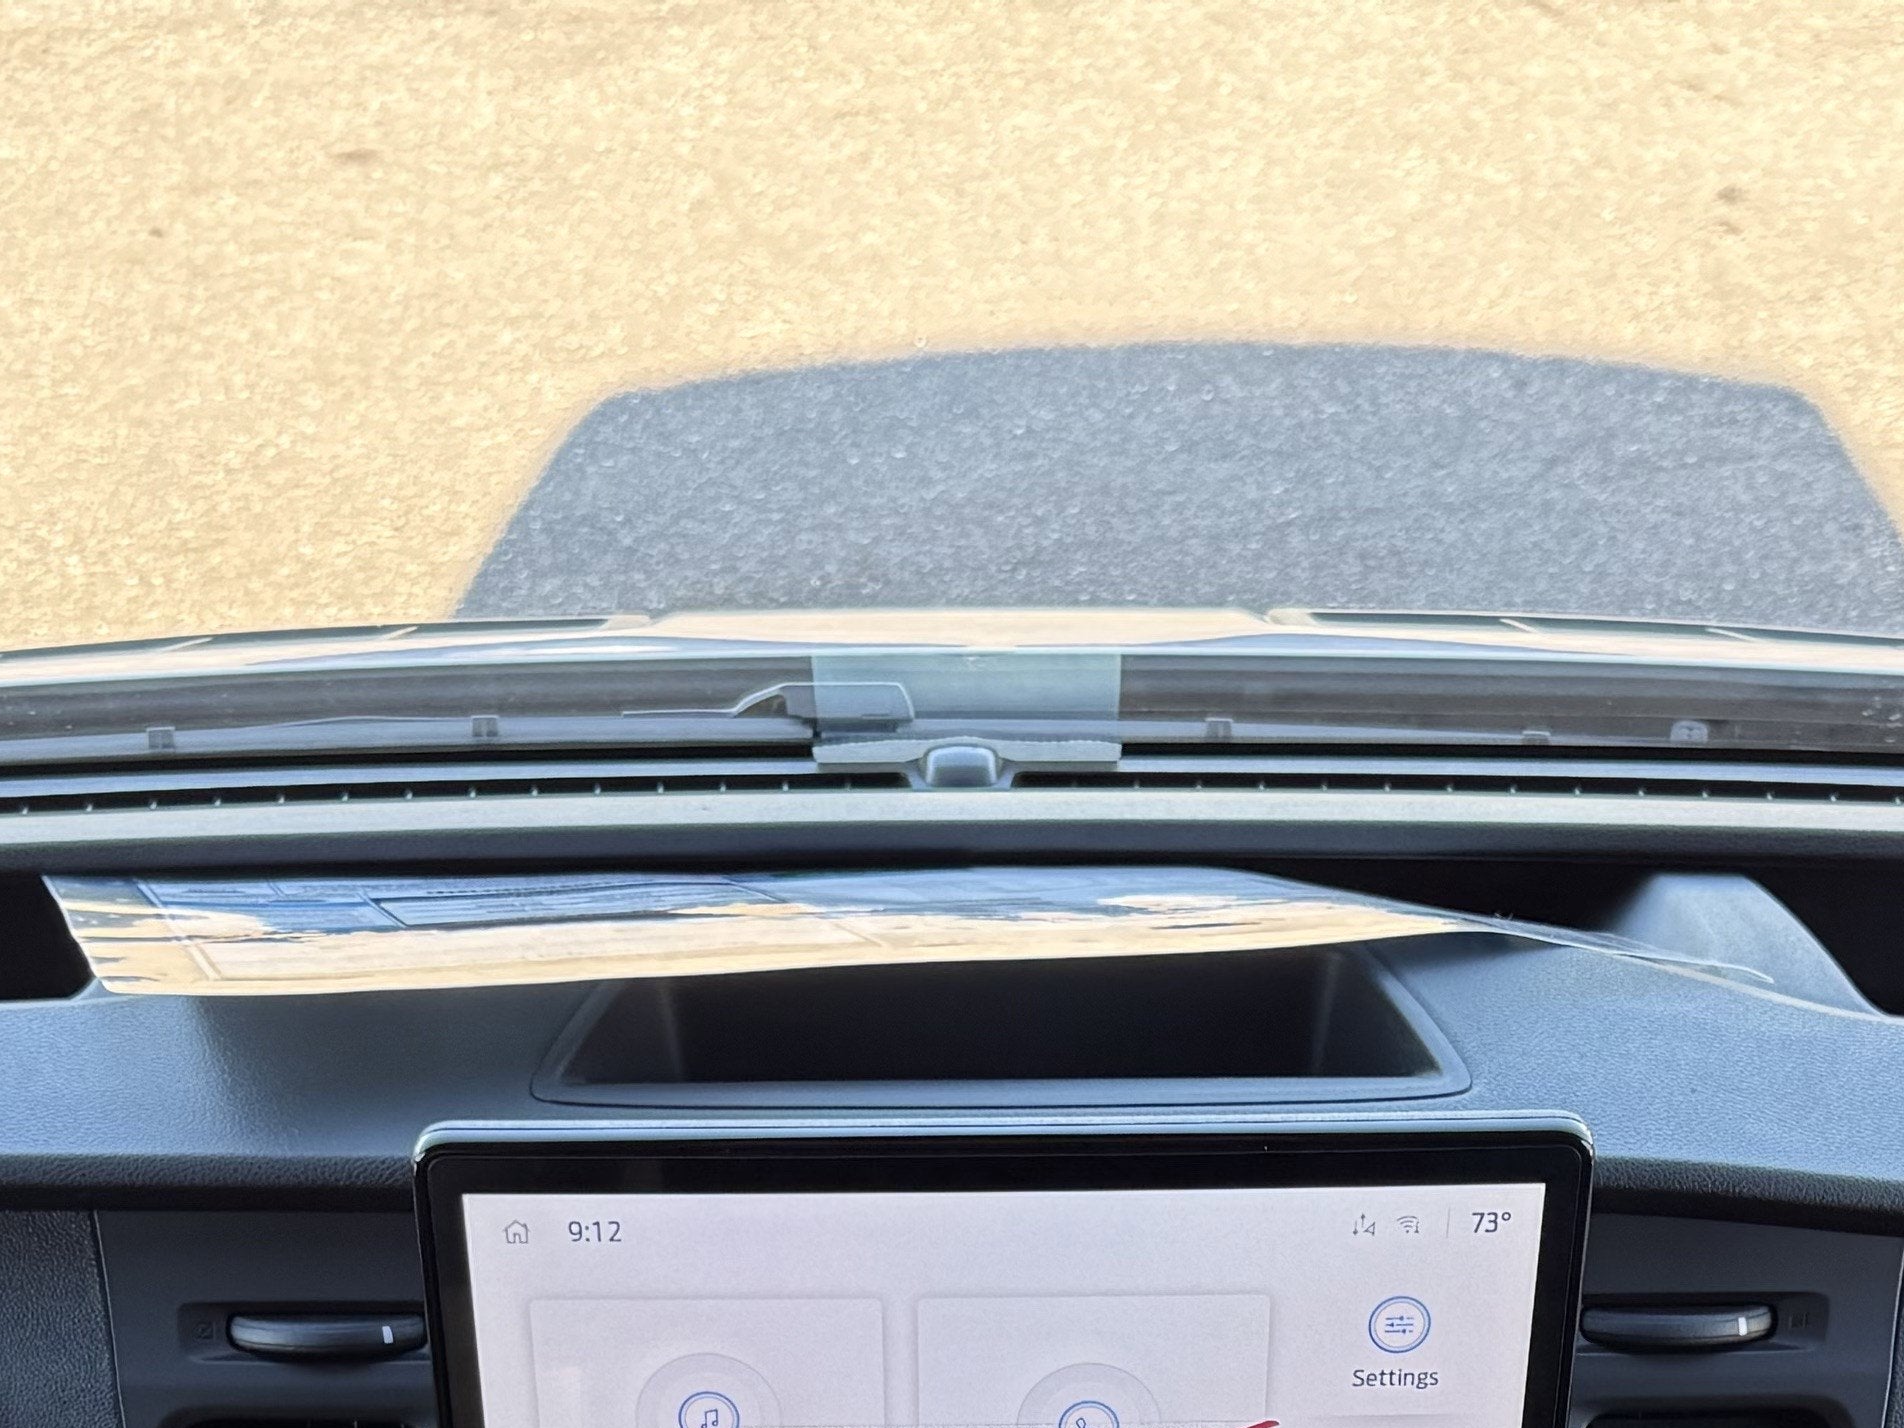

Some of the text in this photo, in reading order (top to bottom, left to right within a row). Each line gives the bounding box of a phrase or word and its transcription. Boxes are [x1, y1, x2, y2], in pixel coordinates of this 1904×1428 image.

[567, 1220, 623, 1244] 9:12
[1471, 1209, 1513, 1234] 73°
[1352, 1366, 1440, 1391] Settings
